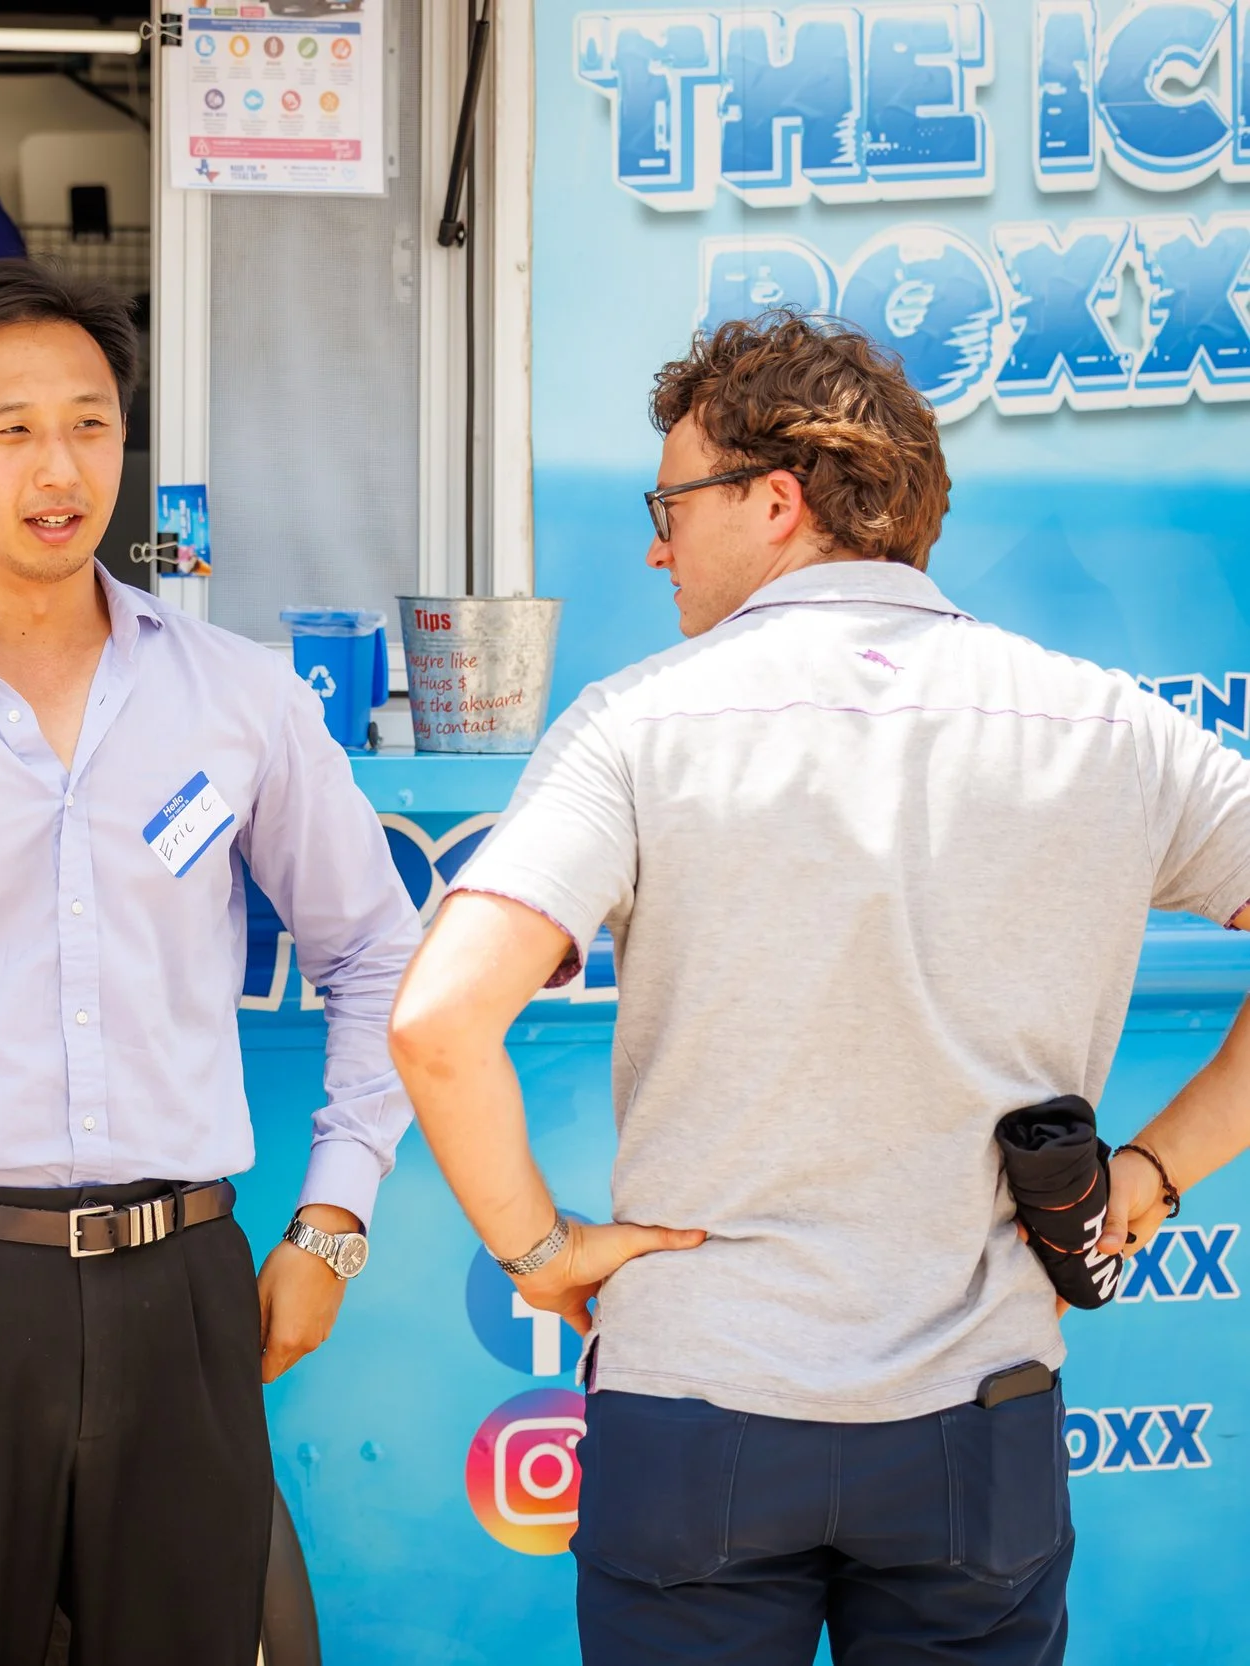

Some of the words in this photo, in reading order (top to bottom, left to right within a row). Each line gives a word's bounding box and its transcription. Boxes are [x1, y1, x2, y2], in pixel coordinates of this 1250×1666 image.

[573, 2, 995, 212] THE
[1034, 0, 1250, 192] IC
[414, 609, 452, 632] Tips
[450, 652, 478, 669] like
[419, 676, 453, 696] Hugs
[458, 675, 467, 692] $
[430, 697, 453, 712] the
[459, 688, 523, 713] akward
[436, 716, 496, 735] contact
[162, 795, 184, 817] Hello
[159, 822, 195, 861] Eric
